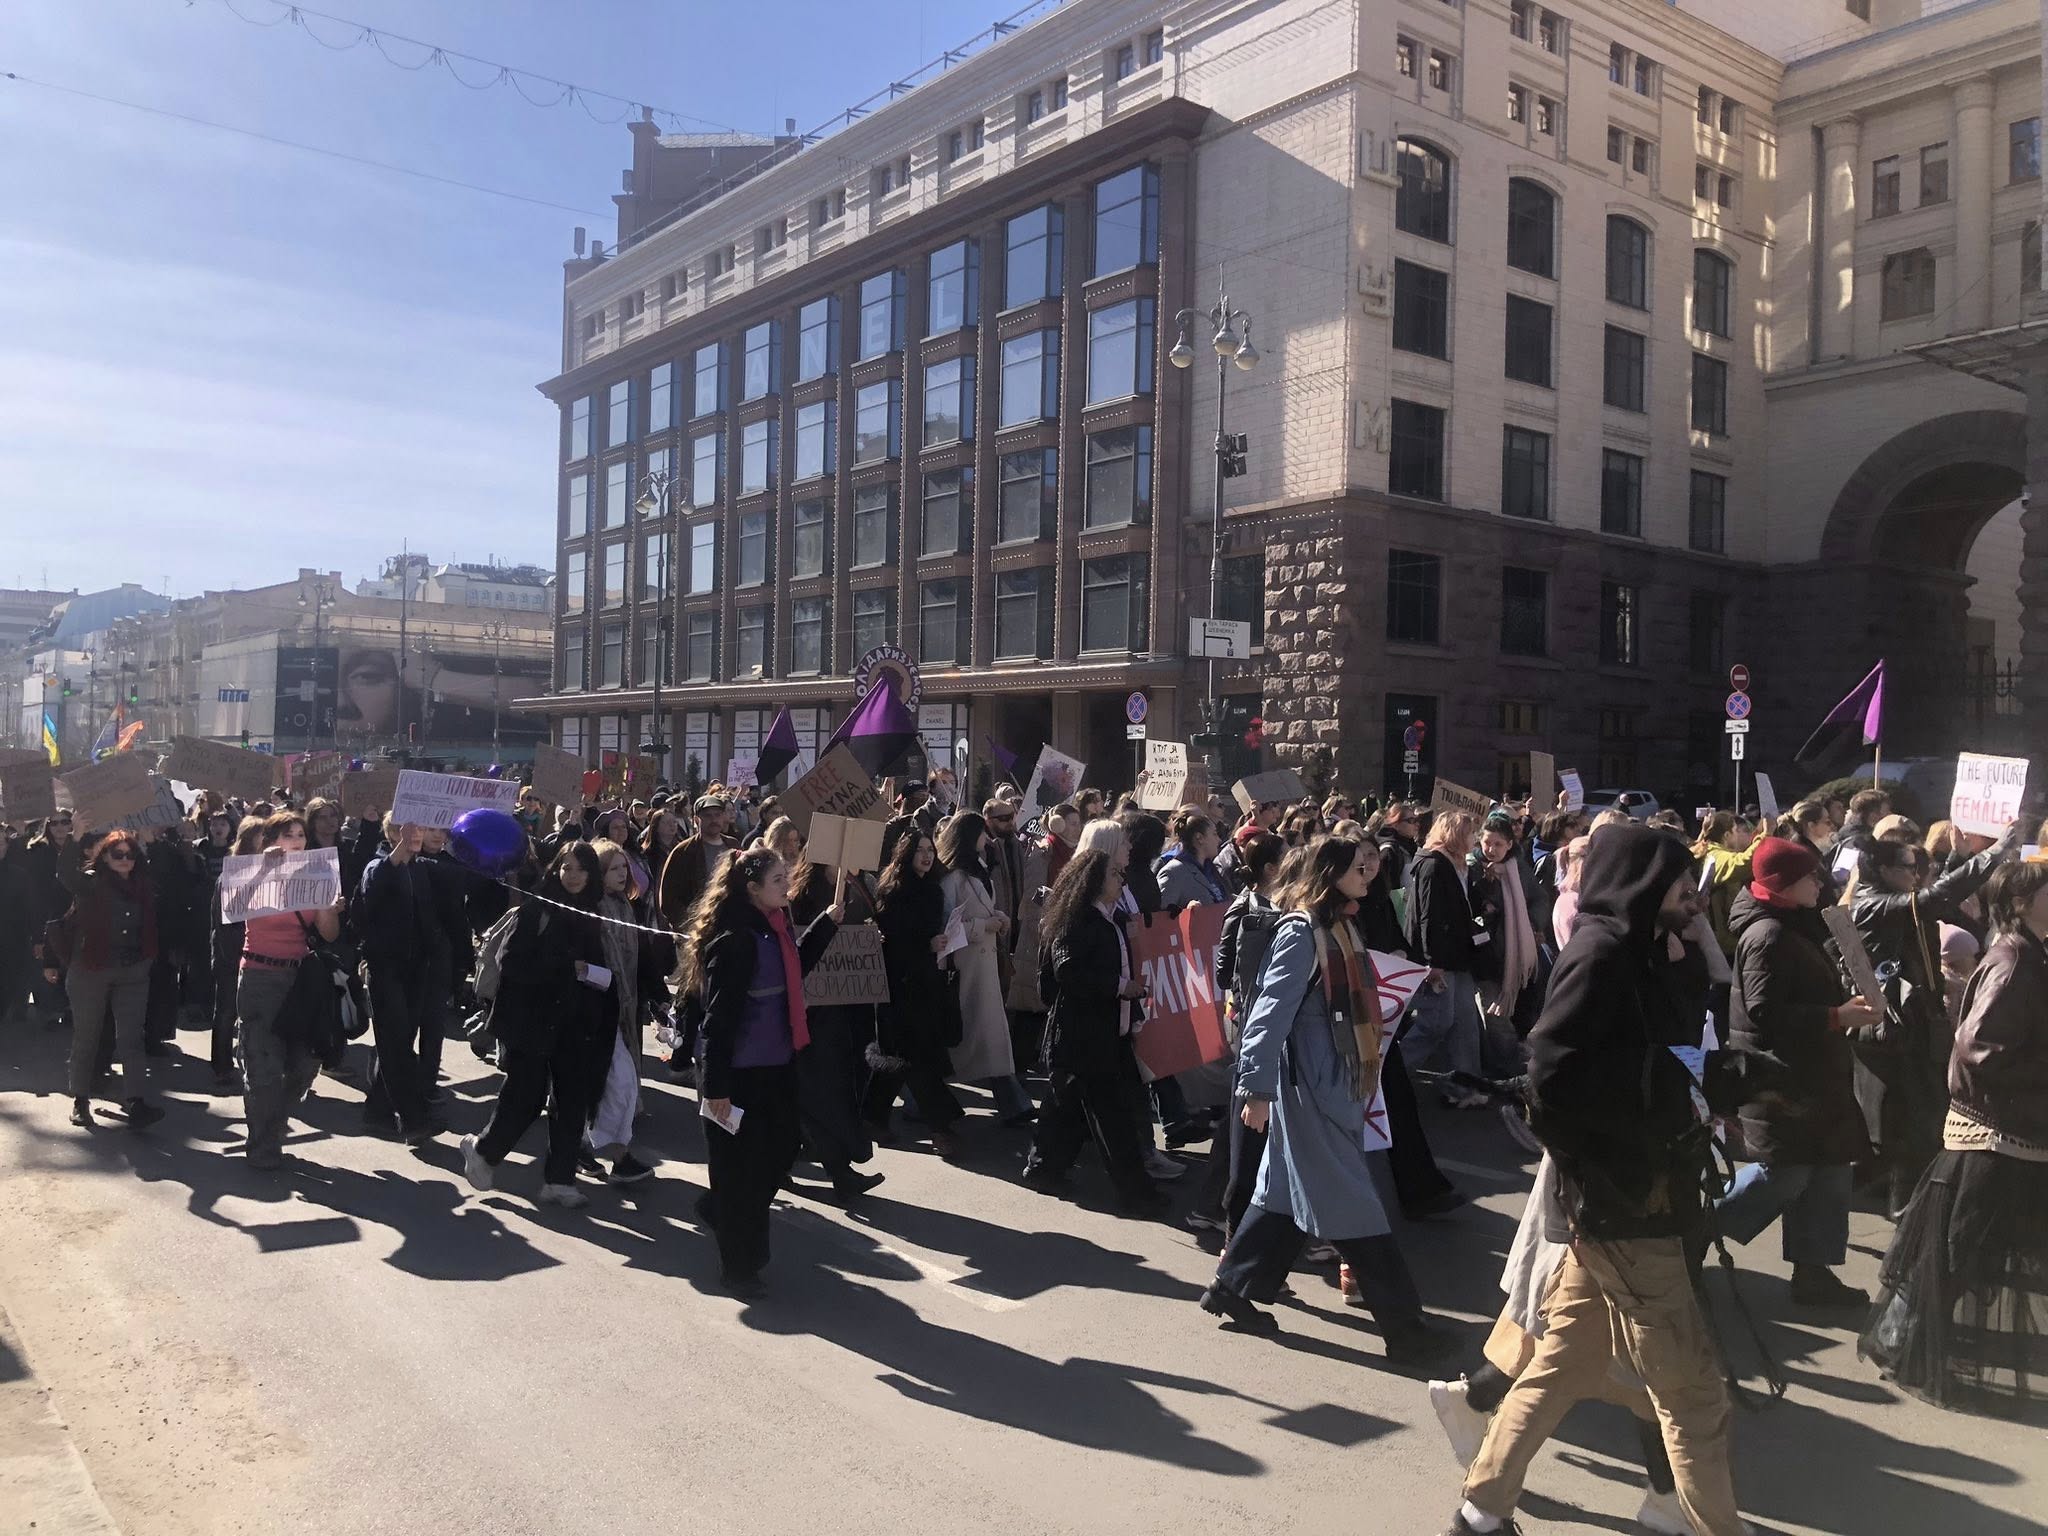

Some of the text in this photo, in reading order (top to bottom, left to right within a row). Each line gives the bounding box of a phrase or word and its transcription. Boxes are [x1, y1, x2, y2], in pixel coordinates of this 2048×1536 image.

[856, 647, 922, 713] ОЛІДАРИЗУЄМОСЯ
[800, 760, 843, 806] FREE
[1961, 760, 2027, 787] THE FUTURE
[817, 780, 860, 813] RYNA
[1983, 784, 1992, 799] IS
[815, 950, 882, 972] ЧАЙНОСТІ
